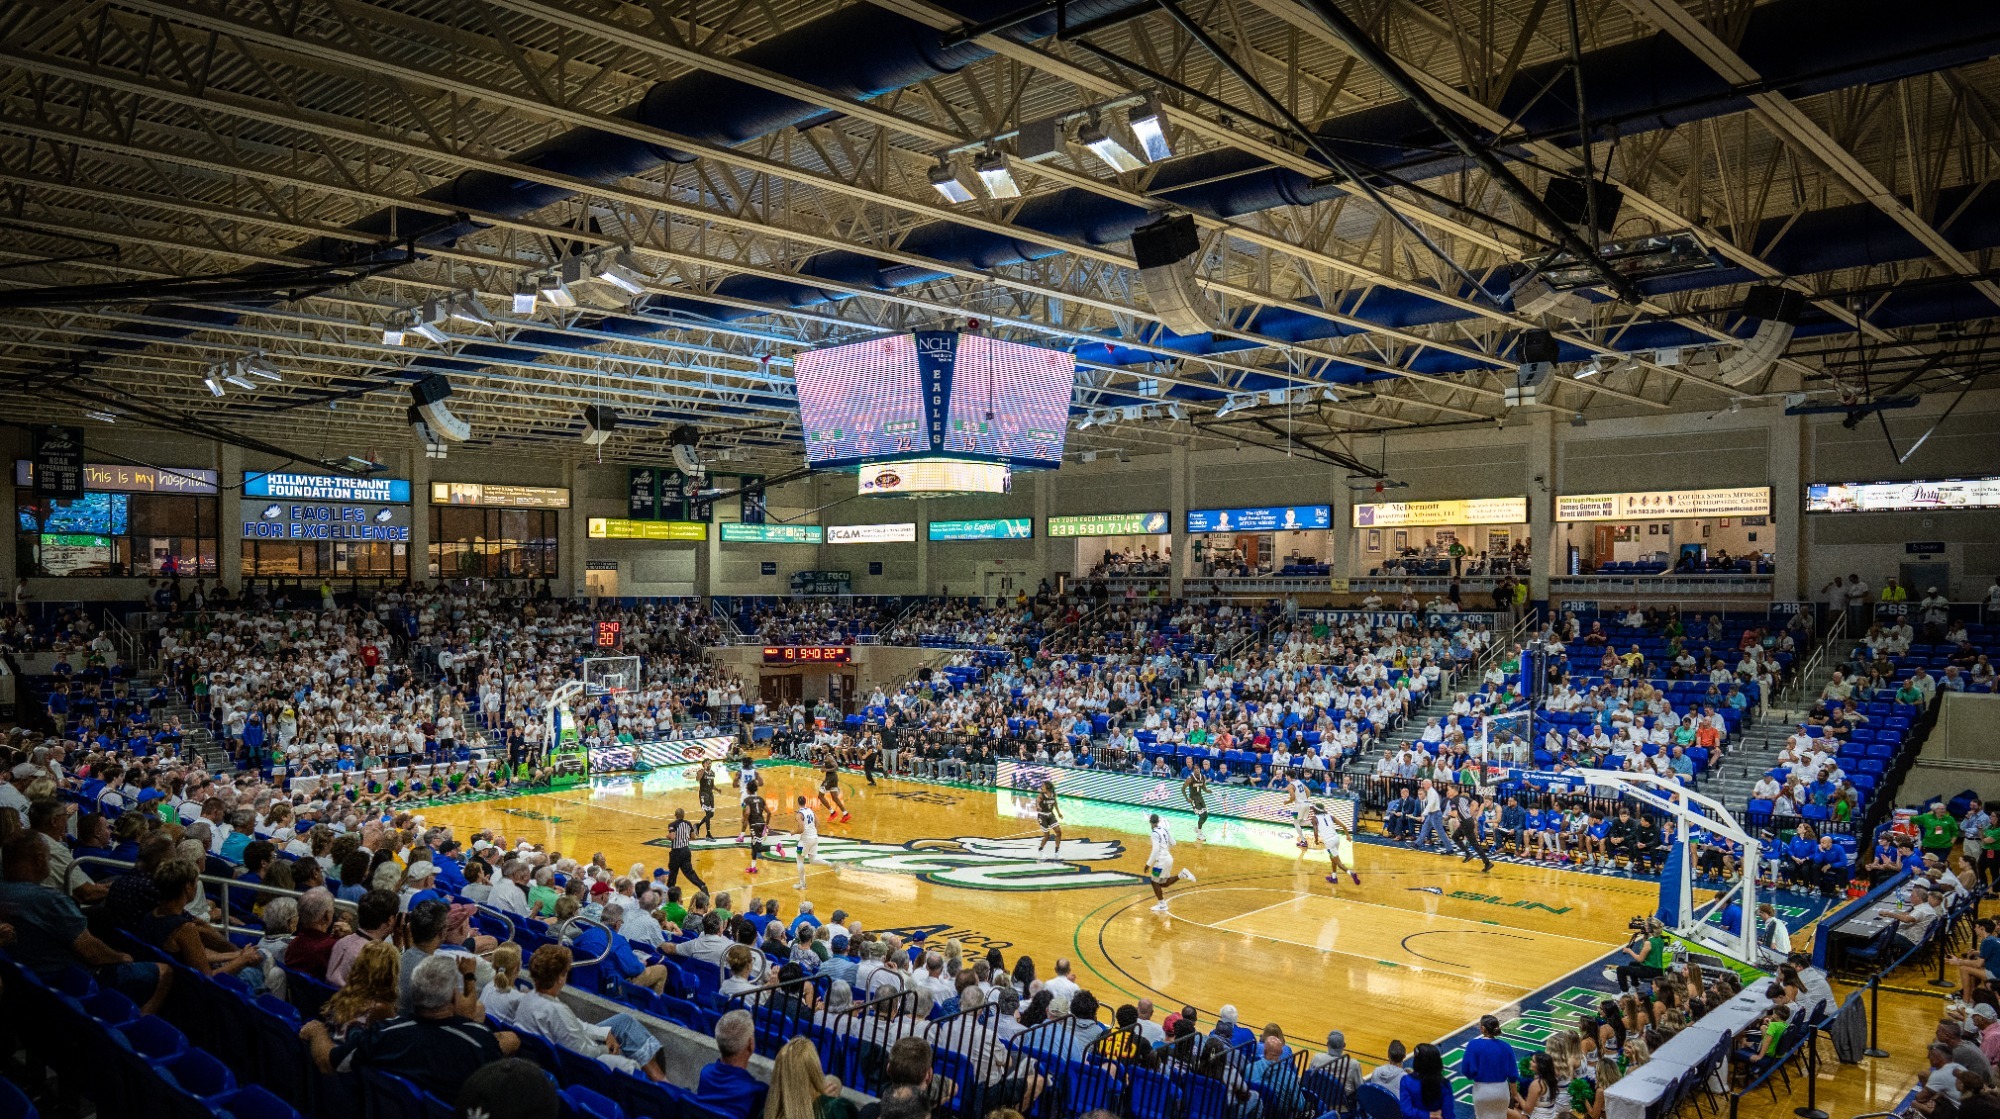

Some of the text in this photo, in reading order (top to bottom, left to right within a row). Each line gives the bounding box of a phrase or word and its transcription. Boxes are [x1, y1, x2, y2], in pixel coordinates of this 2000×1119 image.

[919, 338, 950, 350] NCH
[932, 370, 941, 444] EAGLES
[897, 437, 912, 450] 22
[84, 468, 112, 483] This
[118, 468, 129, 483] is
[134, 472, 154, 492] my
[267, 474, 390, 490] HILLMYER-TREMONT
[268, 485, 390, 500] FOUNDATION SUITE
[1914, 486, 1940, 504] Party
[290, 504, 366, 522] EAGLES
[244, 522, 408, 540] FOR EXCELLENCE
[964, 522, 972, 530] Go
[1052, 522, 1140, 534] 239.590.7145
[836, 530, 860, 538] CAM
[1570, 602, 1586, 610] RR
[1782, 604, 1800, 614] RR
[1888, 604, 1908, 614] SS
[600, 622, 619, 632] 9:40
[600, 632, 614, 645] 28
[785, 648, 793, 658] 19
[800, 648, 820, 658] 9:40
[824, 648, 836, 658] 22
[755, 802, 760, 813] 1
[1324, 818, 1328, 826] 1
